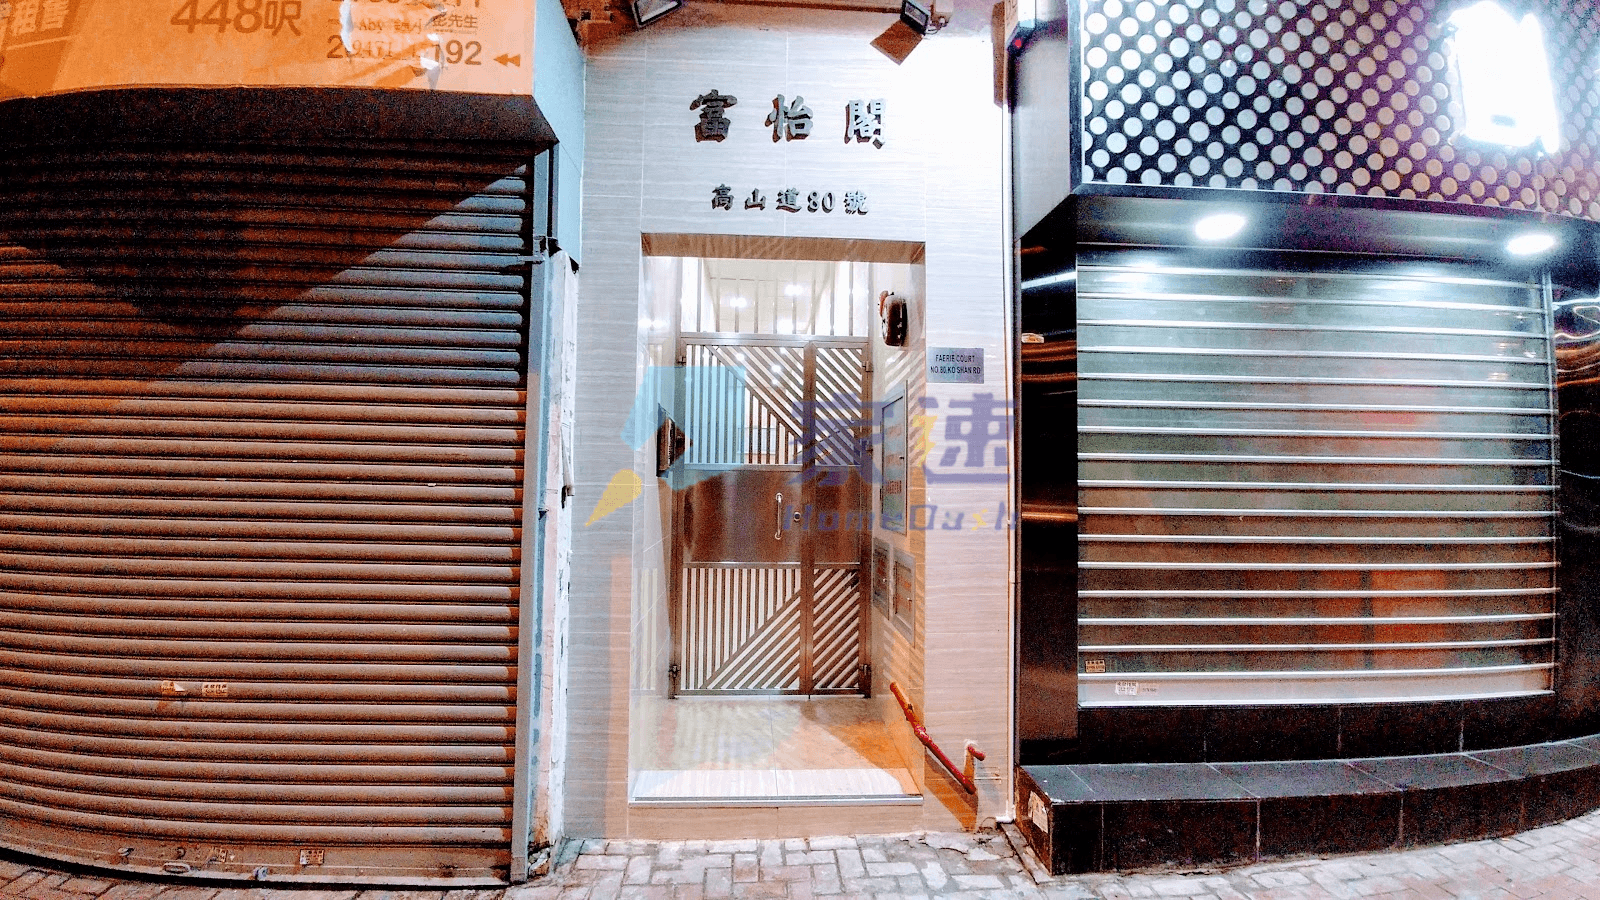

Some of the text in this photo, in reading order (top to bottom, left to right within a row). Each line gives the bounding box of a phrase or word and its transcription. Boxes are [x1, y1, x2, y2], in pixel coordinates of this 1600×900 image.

[690, 89, 887, 149] 富怡閣
[711, 183, 869, 215] 高山道80號
[935, 354, 976, 363] FAERIE COURT
[956, 366, 972, 374] SHAN
[972, 366, 981, 375] RD
